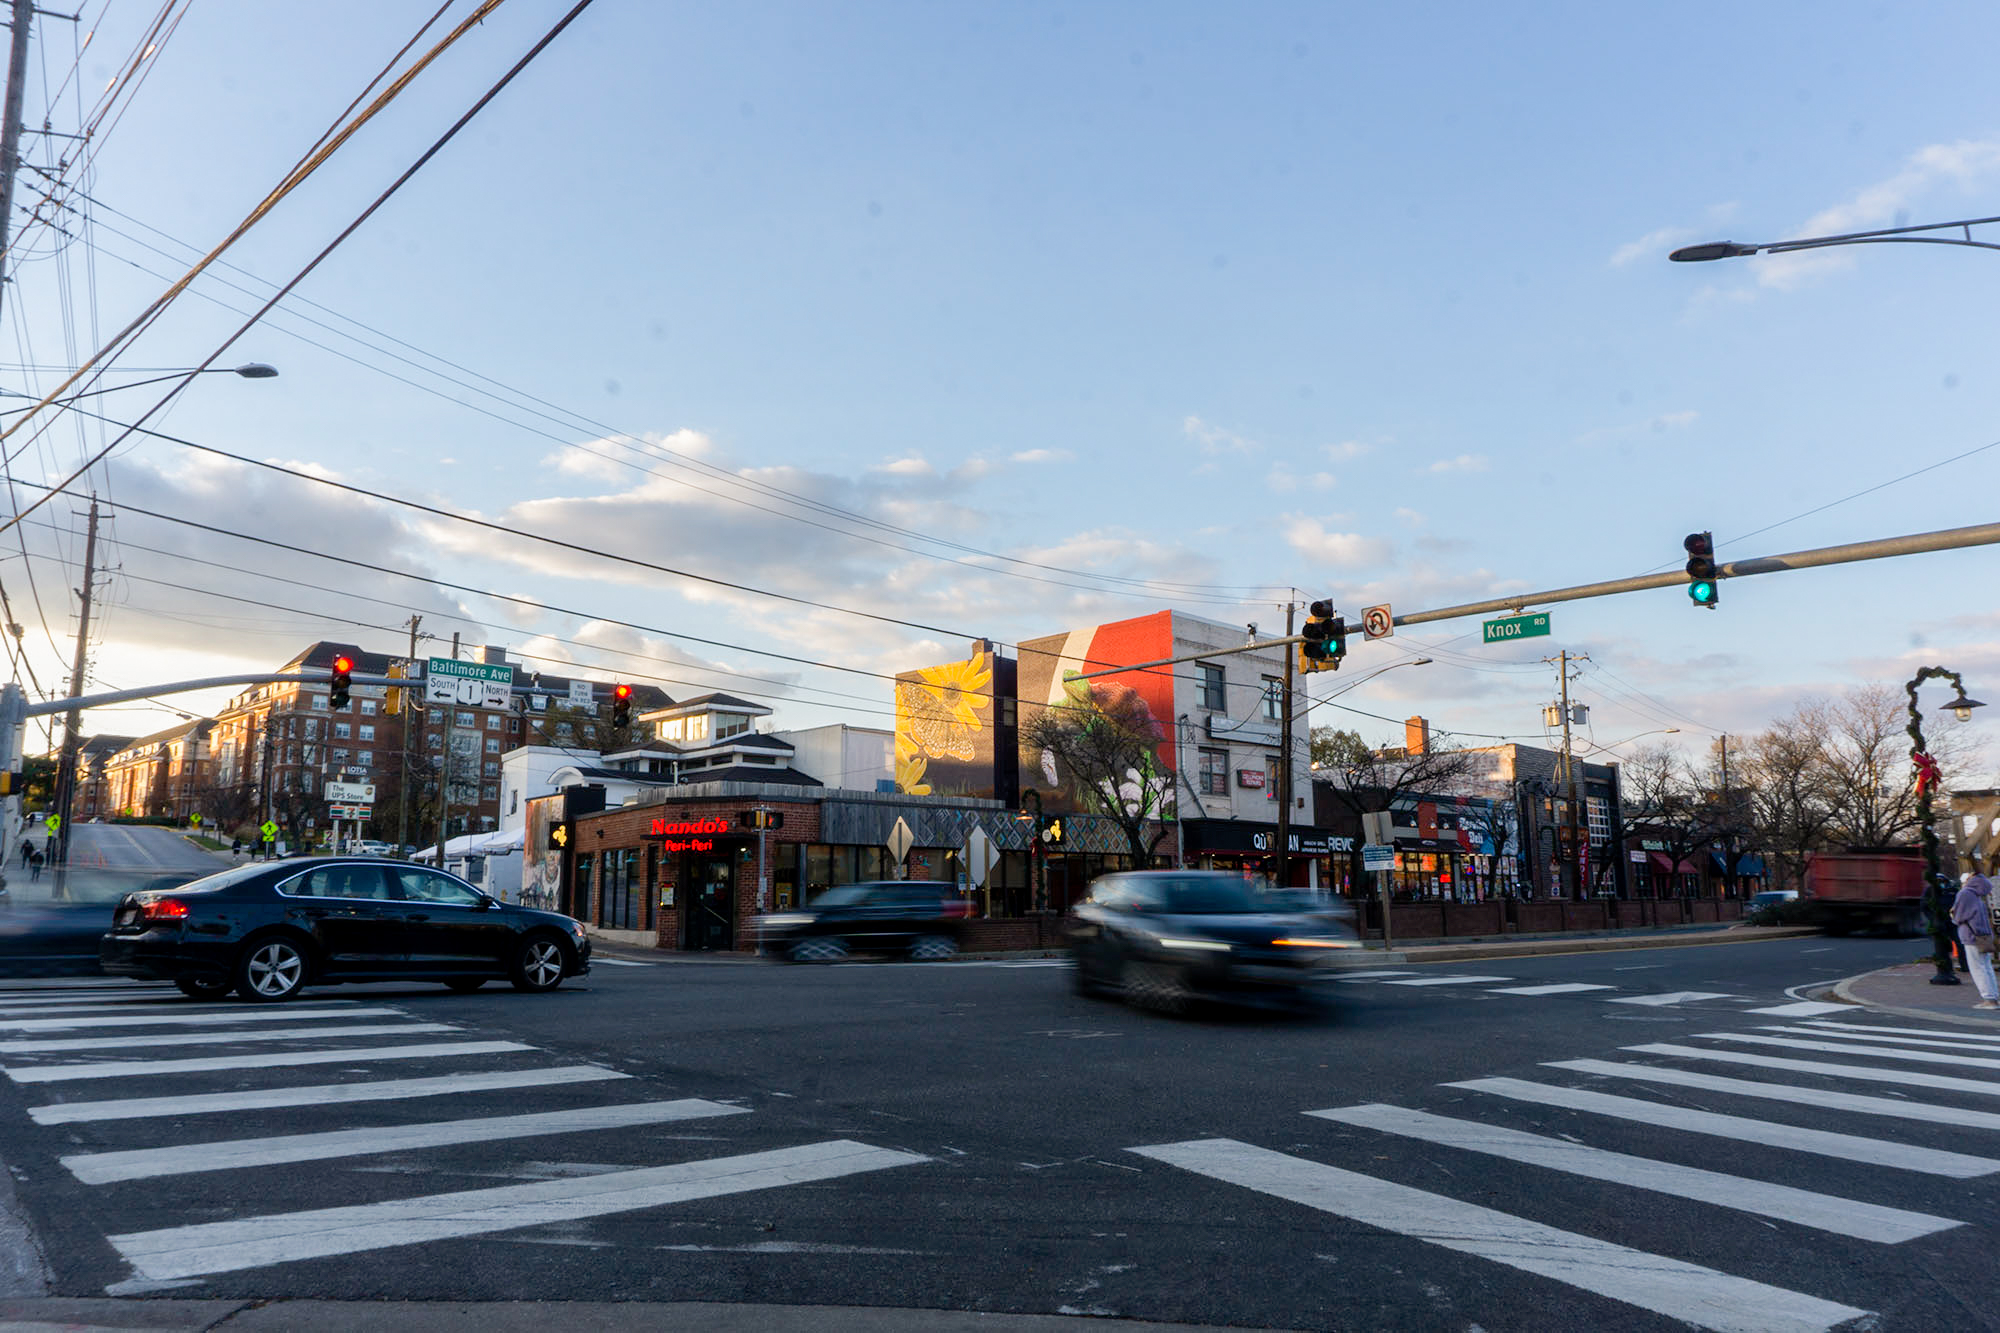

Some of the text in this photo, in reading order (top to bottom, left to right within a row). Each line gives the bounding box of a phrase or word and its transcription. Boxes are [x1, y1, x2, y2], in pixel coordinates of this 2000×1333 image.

[1487, 617, 1546, 639] Knox RD
[431, 660, 510, 681] Baltimore Ave
[430, 677, 456, 690] SOUTH
[485, 684, 509, 697] NORTH
[467, 685, 473, 700] 1
[346, 793, 364, 801] Store
[651, 816, 729, 836] Nando's
[665, 839, 713, 852] Peri-Peri
